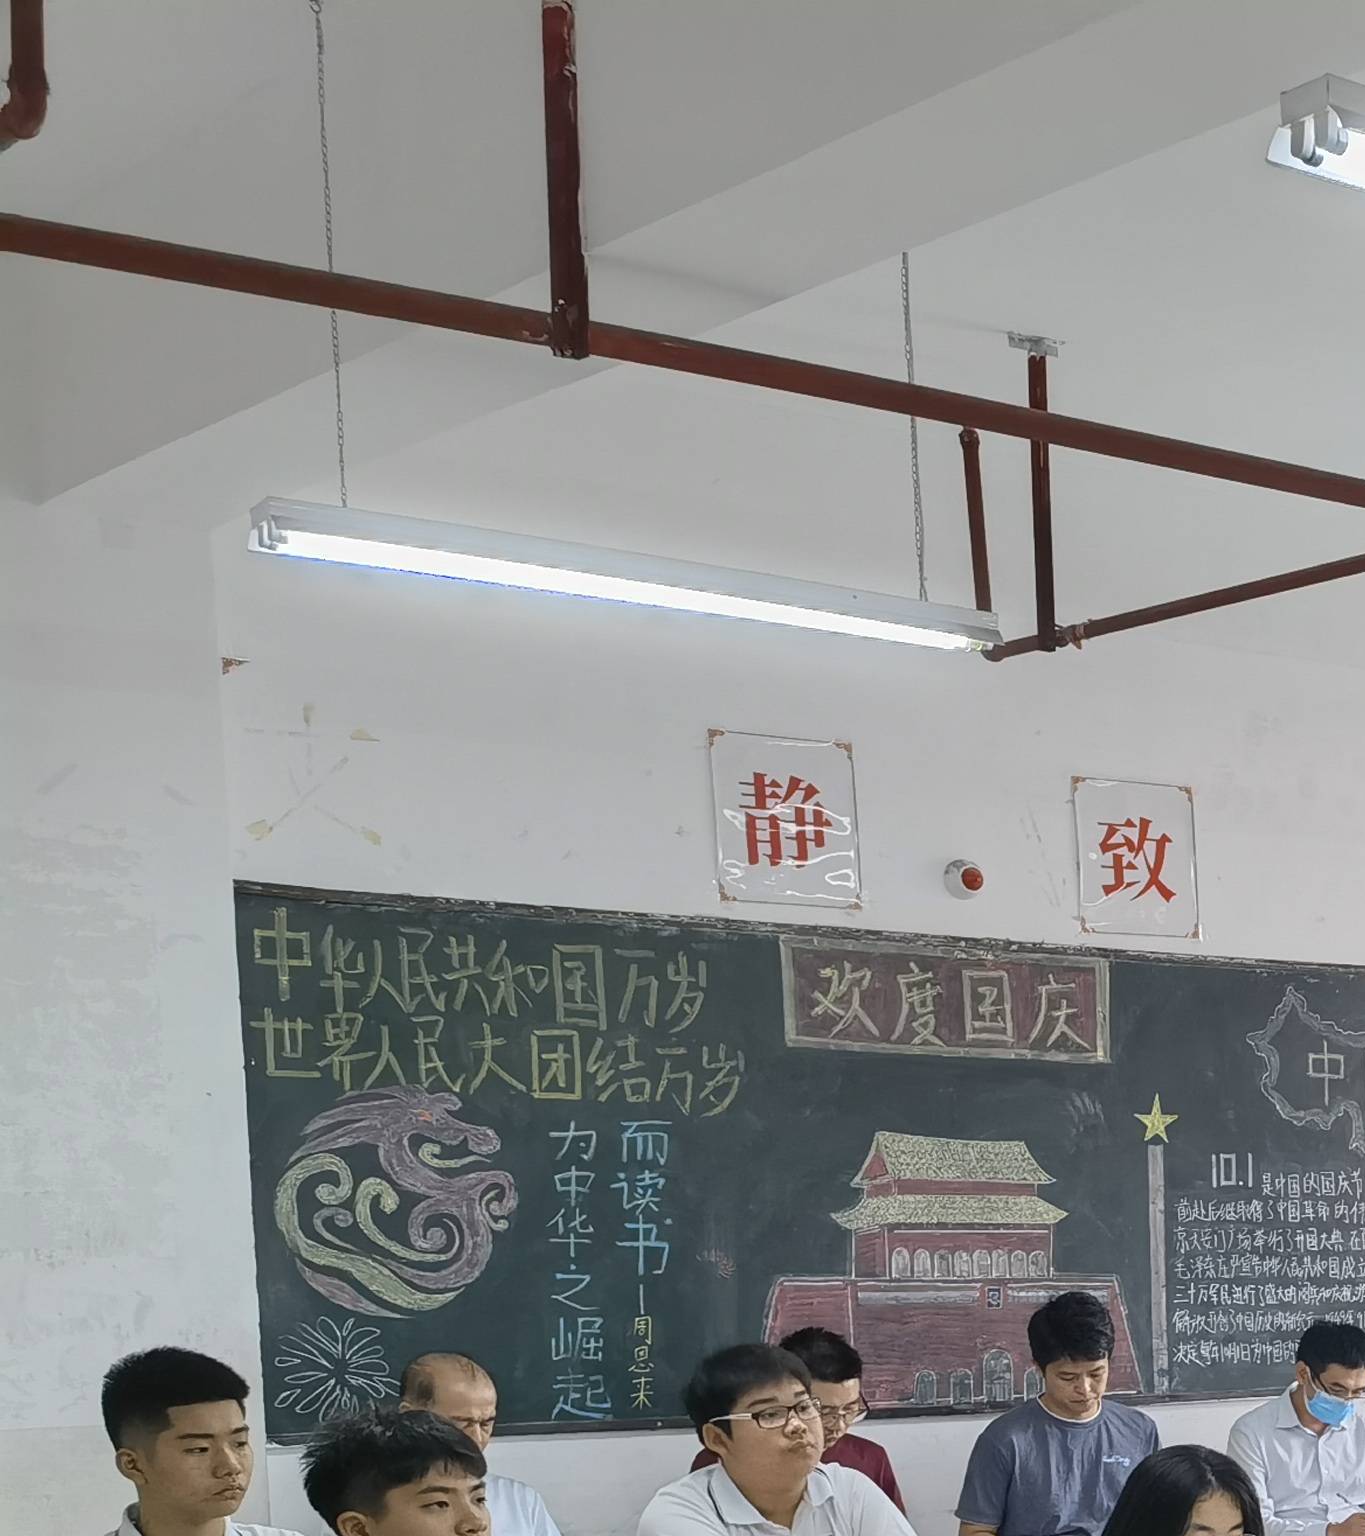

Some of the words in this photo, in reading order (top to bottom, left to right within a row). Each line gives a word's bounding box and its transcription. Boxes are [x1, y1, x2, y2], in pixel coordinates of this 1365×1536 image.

[738, 770, 831, 869] 静
[1098, 817, 1176, 903] 致
[252, 906, 708, 1035] 中华人民共和国万岁
[809, 960, 1092, 1052] 欢度国庆
[249, 1007, 747, 1118] 世界人民大团结万岁
[545, 1120, 616, 1421] 为中华之崛起
